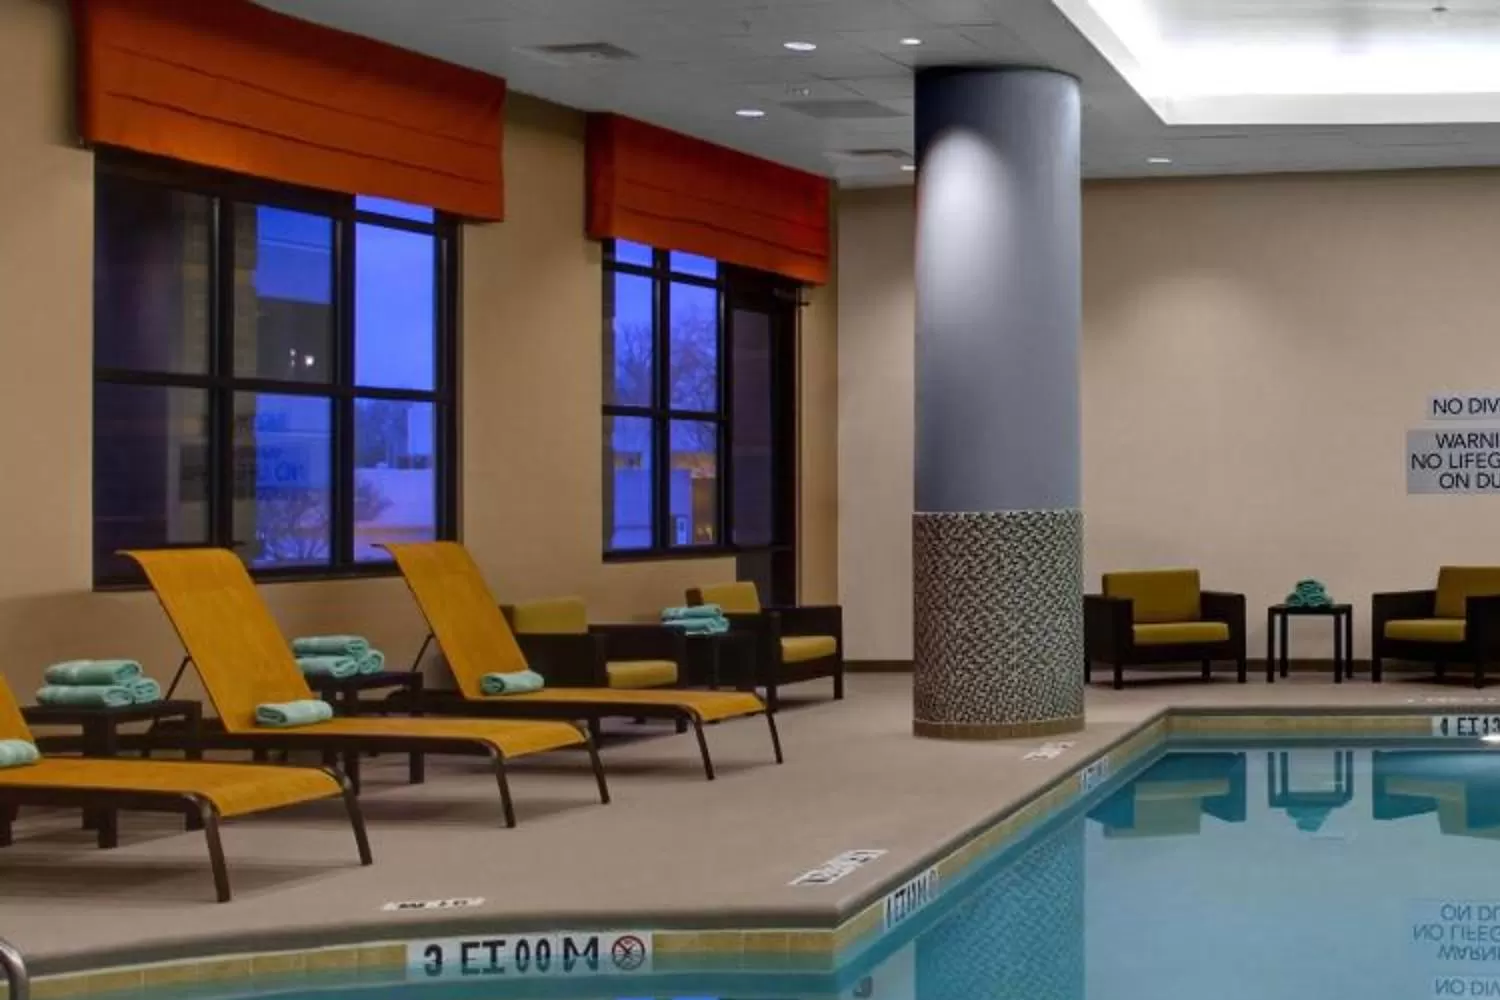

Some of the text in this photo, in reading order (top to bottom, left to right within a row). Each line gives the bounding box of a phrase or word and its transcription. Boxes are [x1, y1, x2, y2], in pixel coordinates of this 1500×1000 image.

[1433, 398, 1463, 415] NO
[1411, 453, 1442, 470] NO
[1439, 473, 1470, 490] ON
